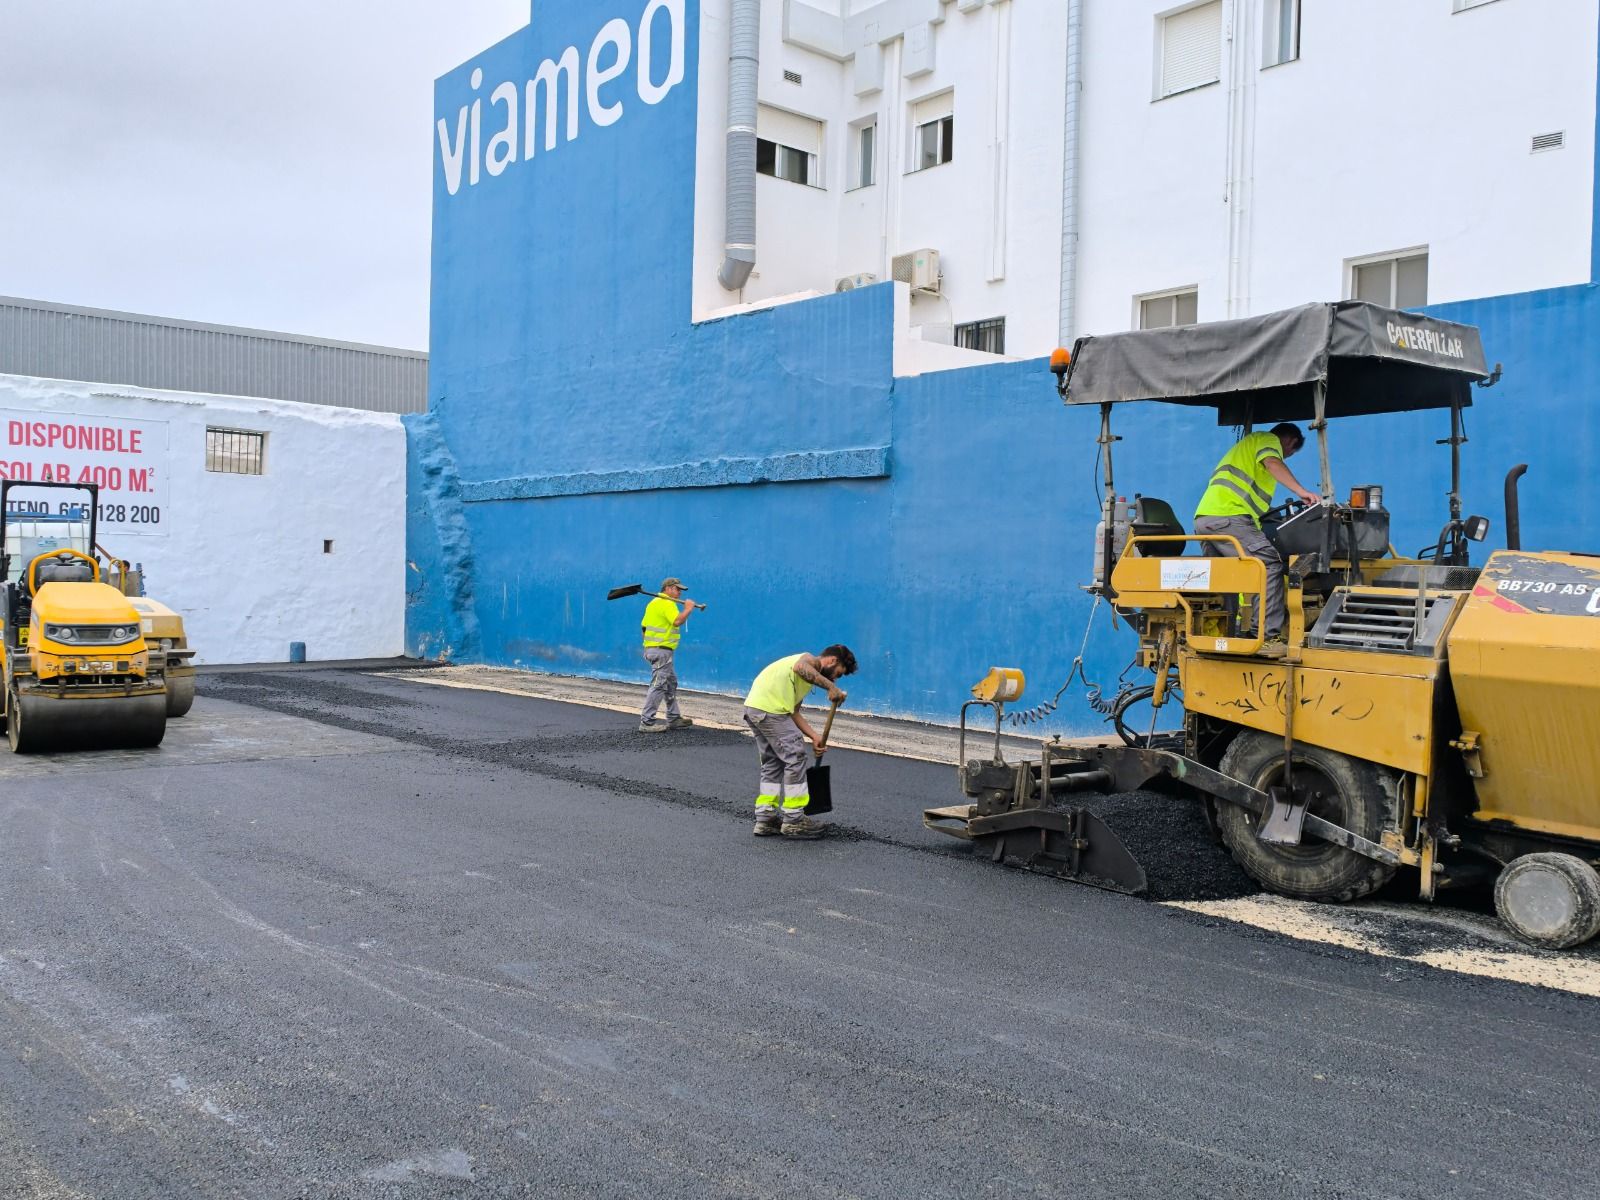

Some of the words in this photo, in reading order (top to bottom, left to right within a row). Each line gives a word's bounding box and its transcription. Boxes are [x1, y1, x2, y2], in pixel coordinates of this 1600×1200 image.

[1386, 320, 1464, 359] CATERPILLAR
[8, 420, 142, 454] DISPONIBLE
[77, 465, 122, 491] 400
[97, 503, 125, 522] 128
[130, 505, 160, 524] 200
[1497, 579, 1557, 594] BB730
